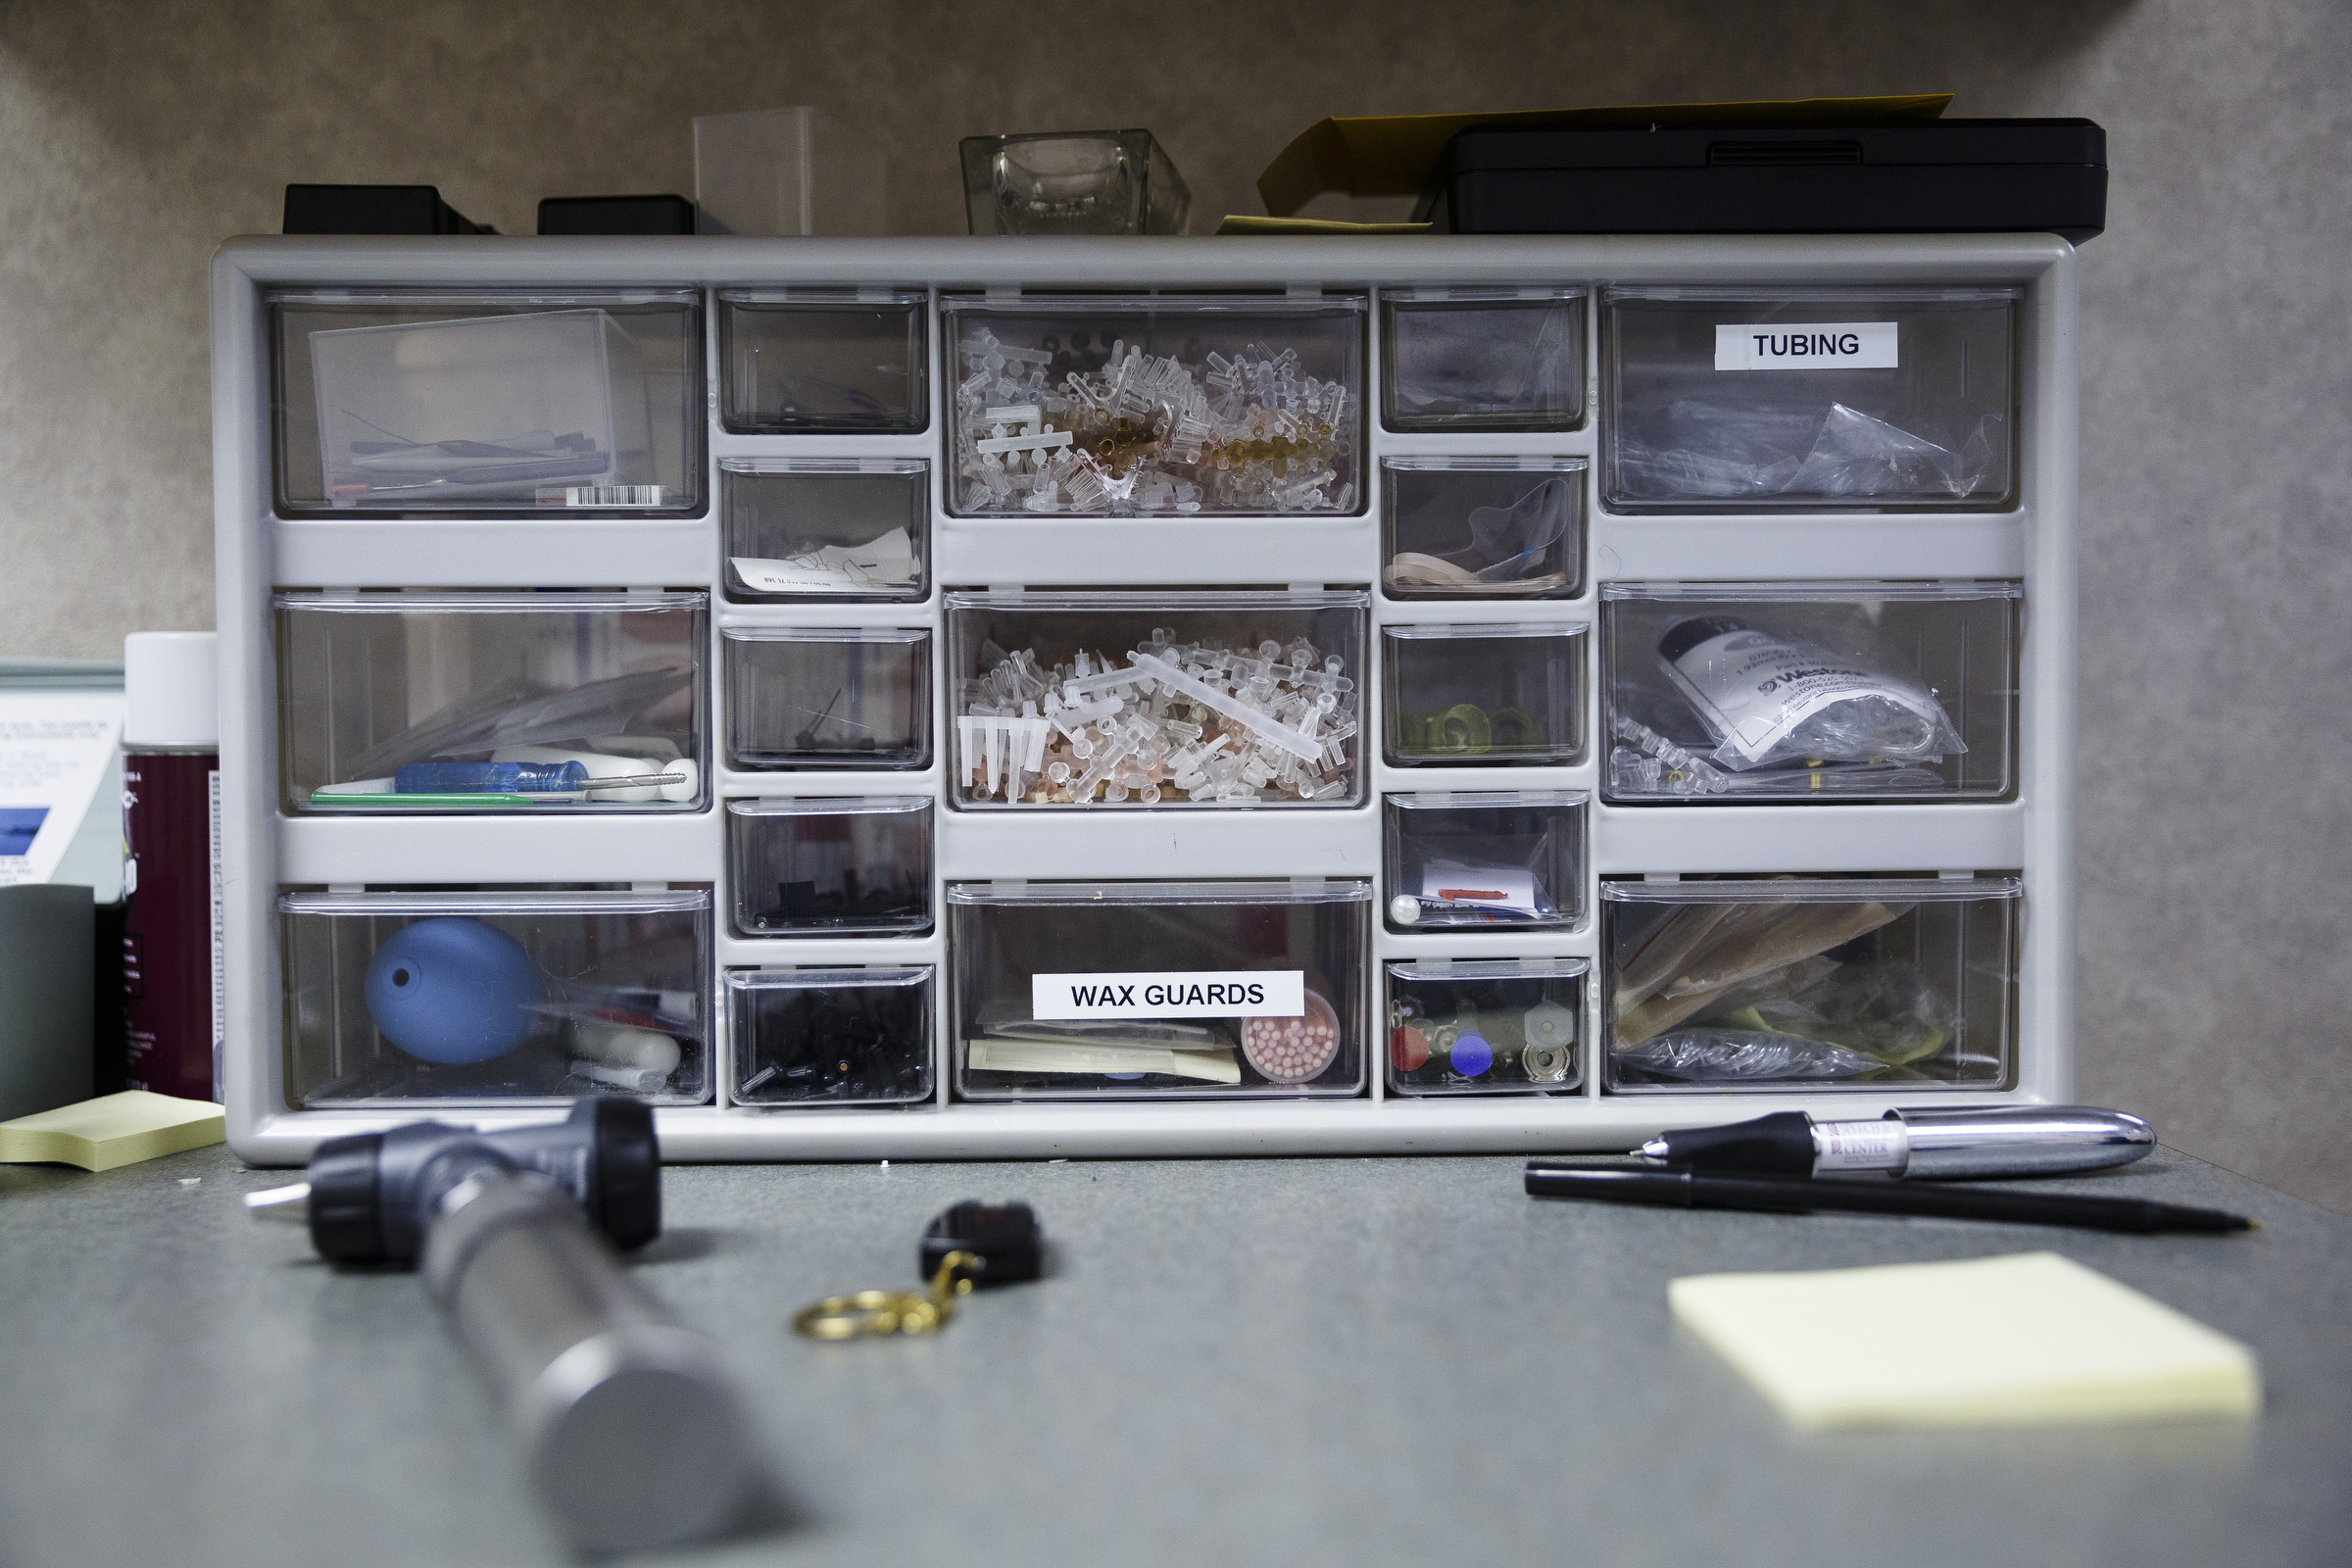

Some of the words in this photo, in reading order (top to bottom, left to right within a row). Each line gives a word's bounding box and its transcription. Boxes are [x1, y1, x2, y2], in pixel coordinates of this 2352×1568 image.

[1752, 333, 1859, 357] TUBING
[1070, 983, 1136, 1007] WAX
[1145, 983, 1264, 1006] GUARDS
